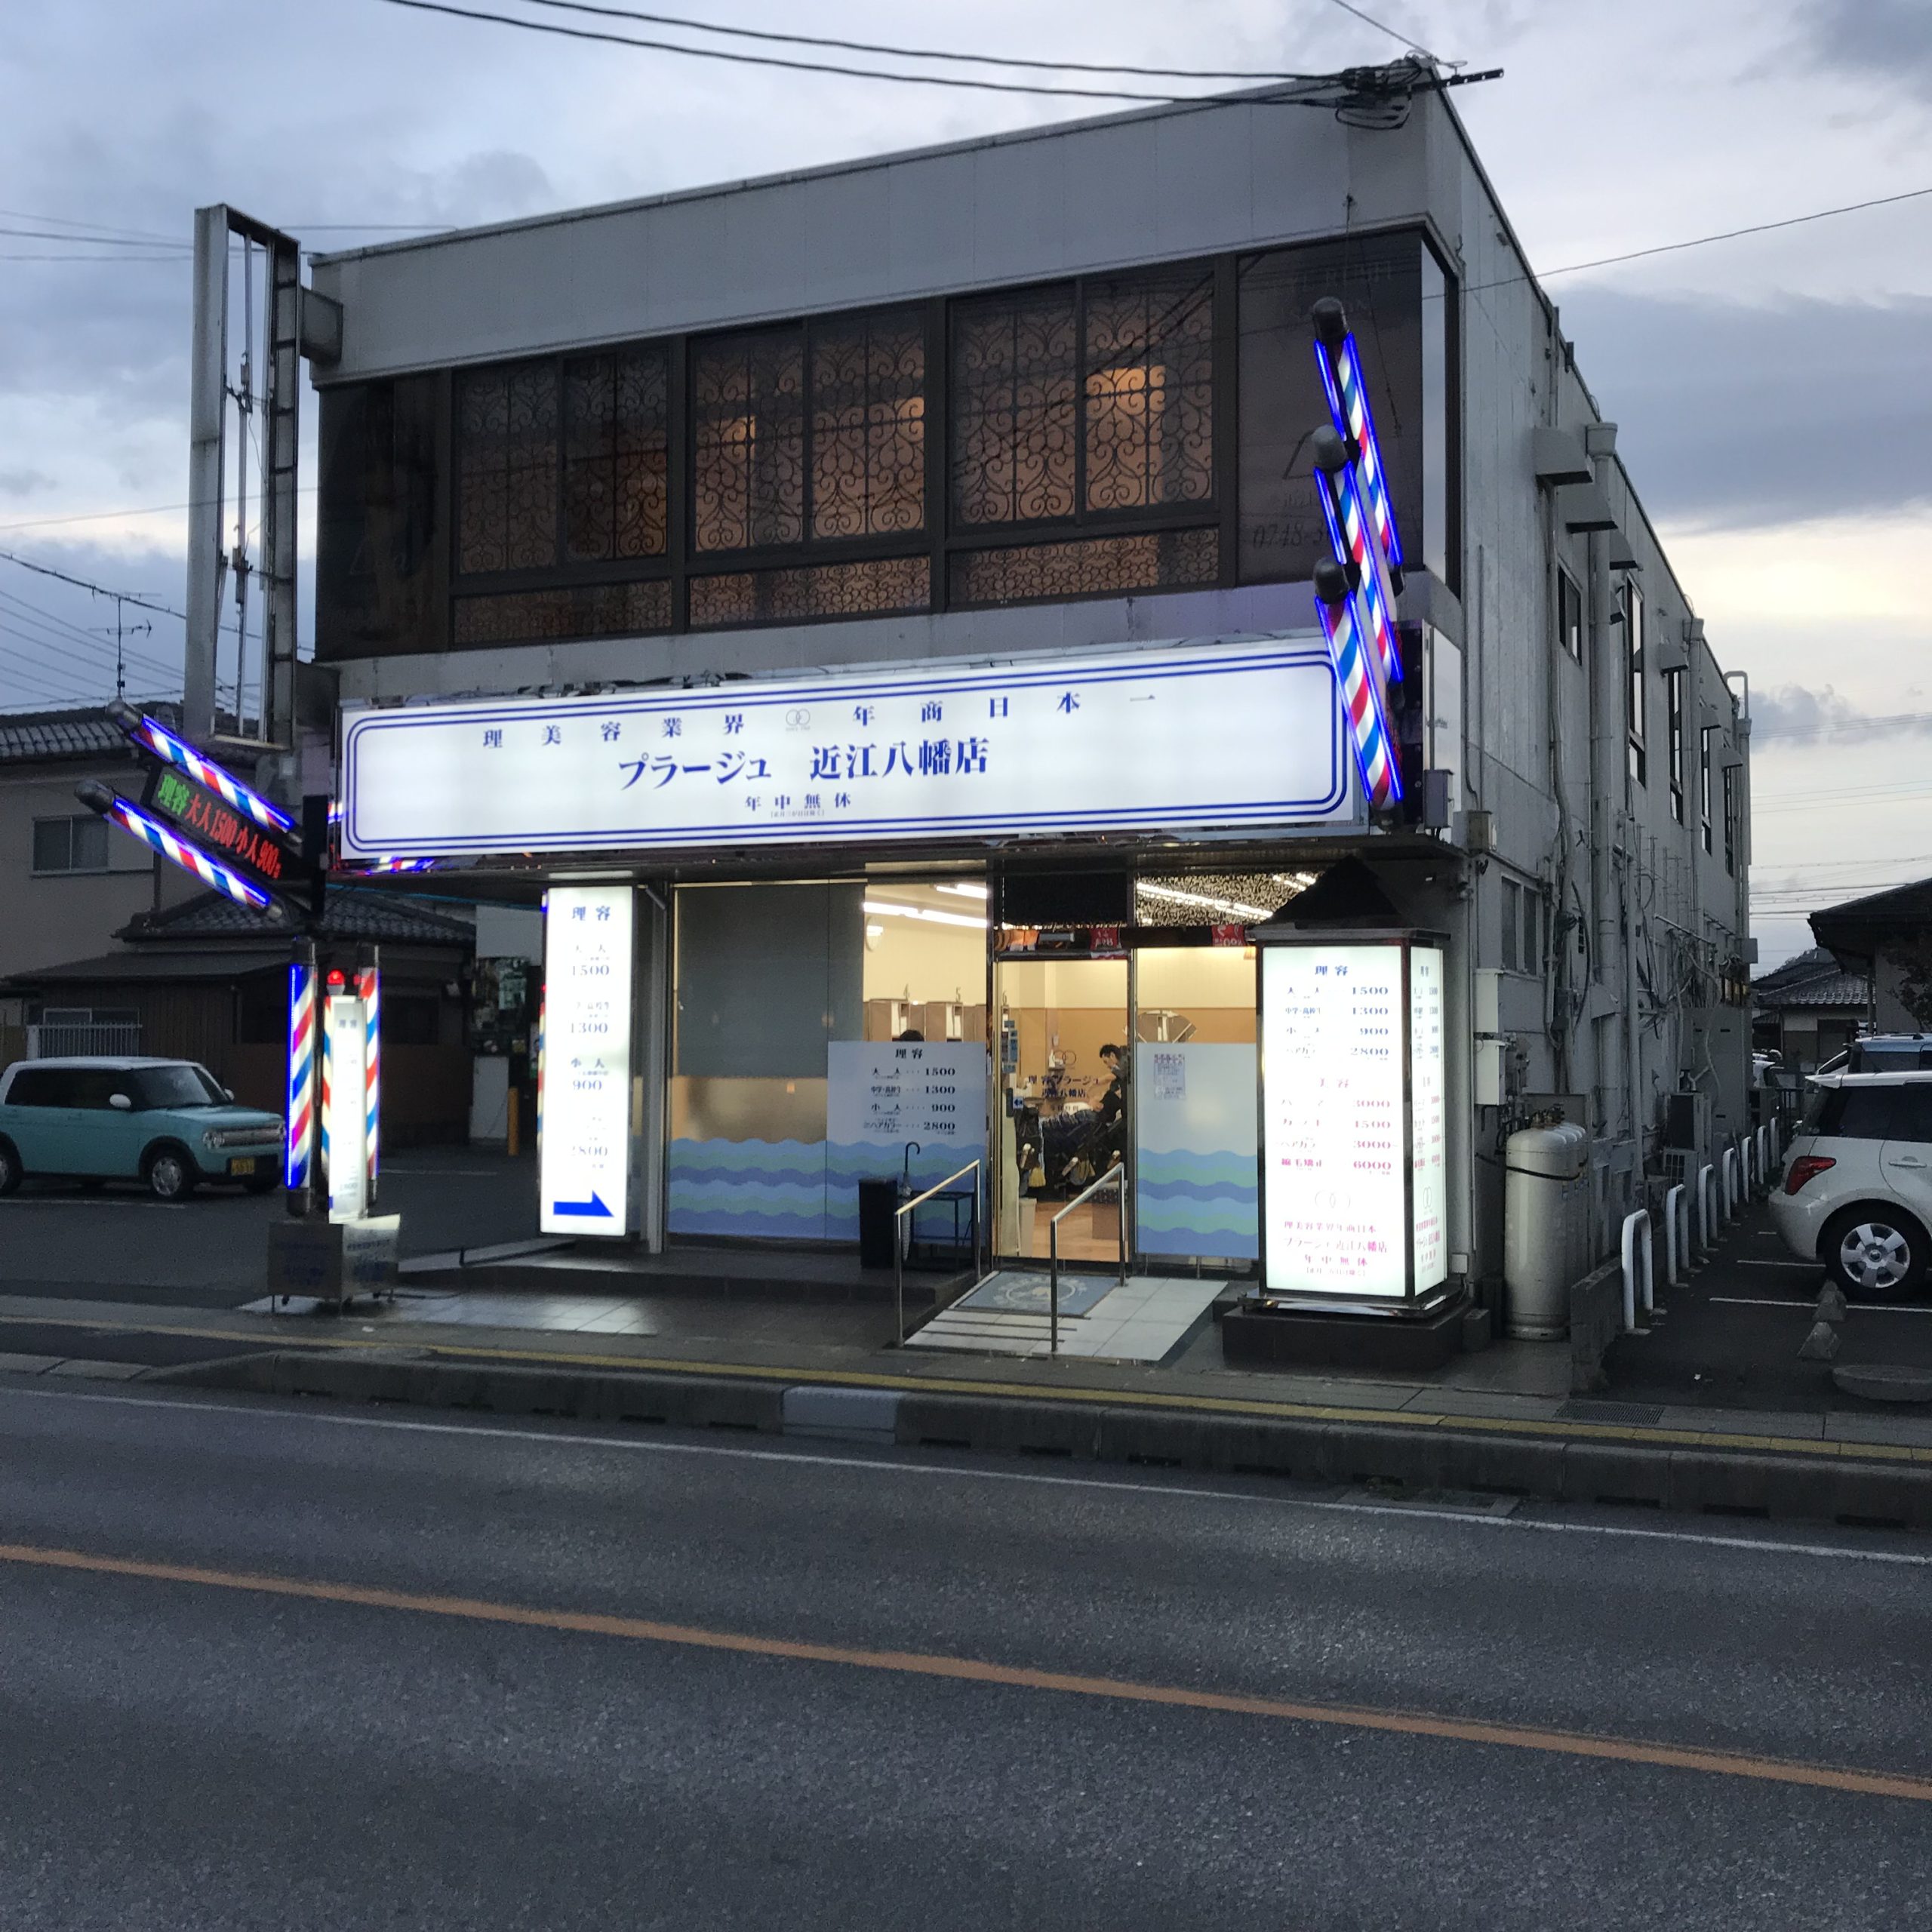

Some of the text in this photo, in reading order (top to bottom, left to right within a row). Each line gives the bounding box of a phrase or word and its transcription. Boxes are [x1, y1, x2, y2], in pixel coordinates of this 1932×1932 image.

[482, 691, 1155, 749] 理美容業界 年商日本一
[618, 737, 990, 790] プラージュ 近江八幡店
[745, 792, 851, 812] 年中無休
[571, 905, 611, 921] 理容
[572, 964, 610, 977] 1500
[1314, 964, 1349, 977] 理容
[1352, 986, 1389, 995] 1500
[1352, 1007, 1389, 1016] 1300
[571, 1021, 608, 1035] 1300
[1359, 1027, 1389, 1036] 900
[895, 1048, 923, 1060] 理容
[1350, 1047, 1389, 1056] 2800
[925, 1067, 956, 1076] 1500
[572, 1079, 603, 1091] 900
[925, 1085, 956, 1094] 1300
[931, 1103, 956, 1113] 900
[923, 1121, 956, 1131] 2800
[1355, 1119, 1392, 1129] 1500
[1352, 1160, 1392, 1171] 6000
